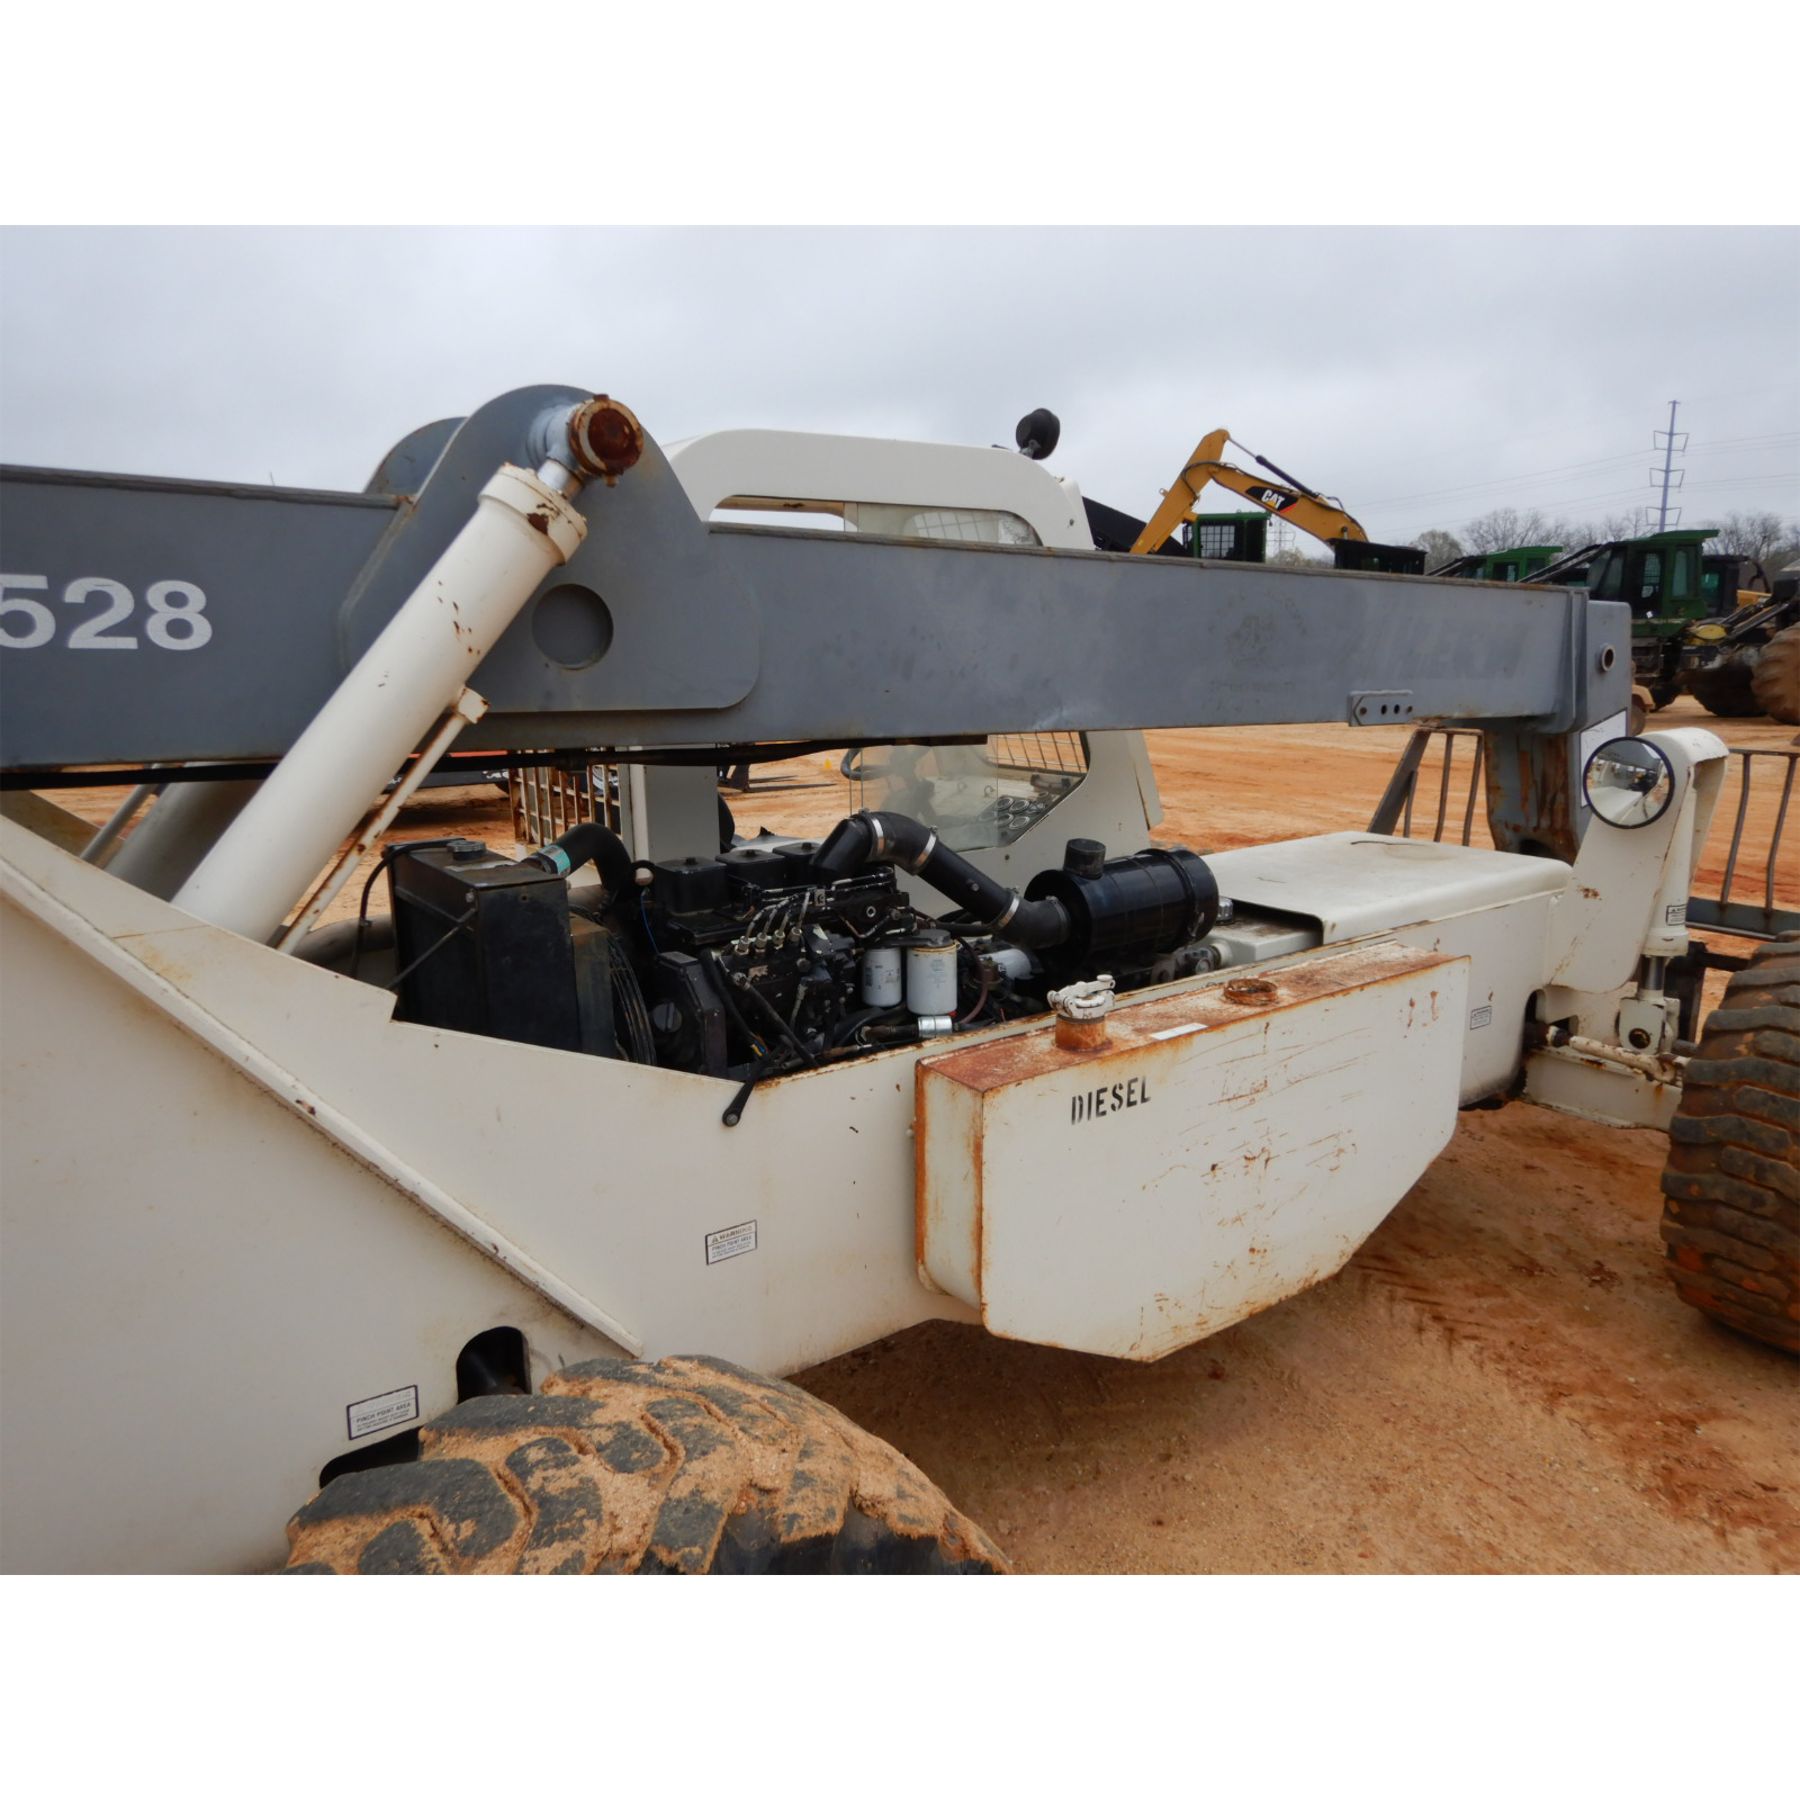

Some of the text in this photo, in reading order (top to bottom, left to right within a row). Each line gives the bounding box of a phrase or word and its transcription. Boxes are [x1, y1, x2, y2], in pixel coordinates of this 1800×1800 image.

[1261, 489, 1285, 510] CAT
[0, 573, 213, 650] 528
[1071, 1076, 1151, 1125] DIESEL
[356, 1412, 376, 1423] PINCH
[376, 1406, 394, 1417] POINT
[396, 1401, 411, 1411] AREA
